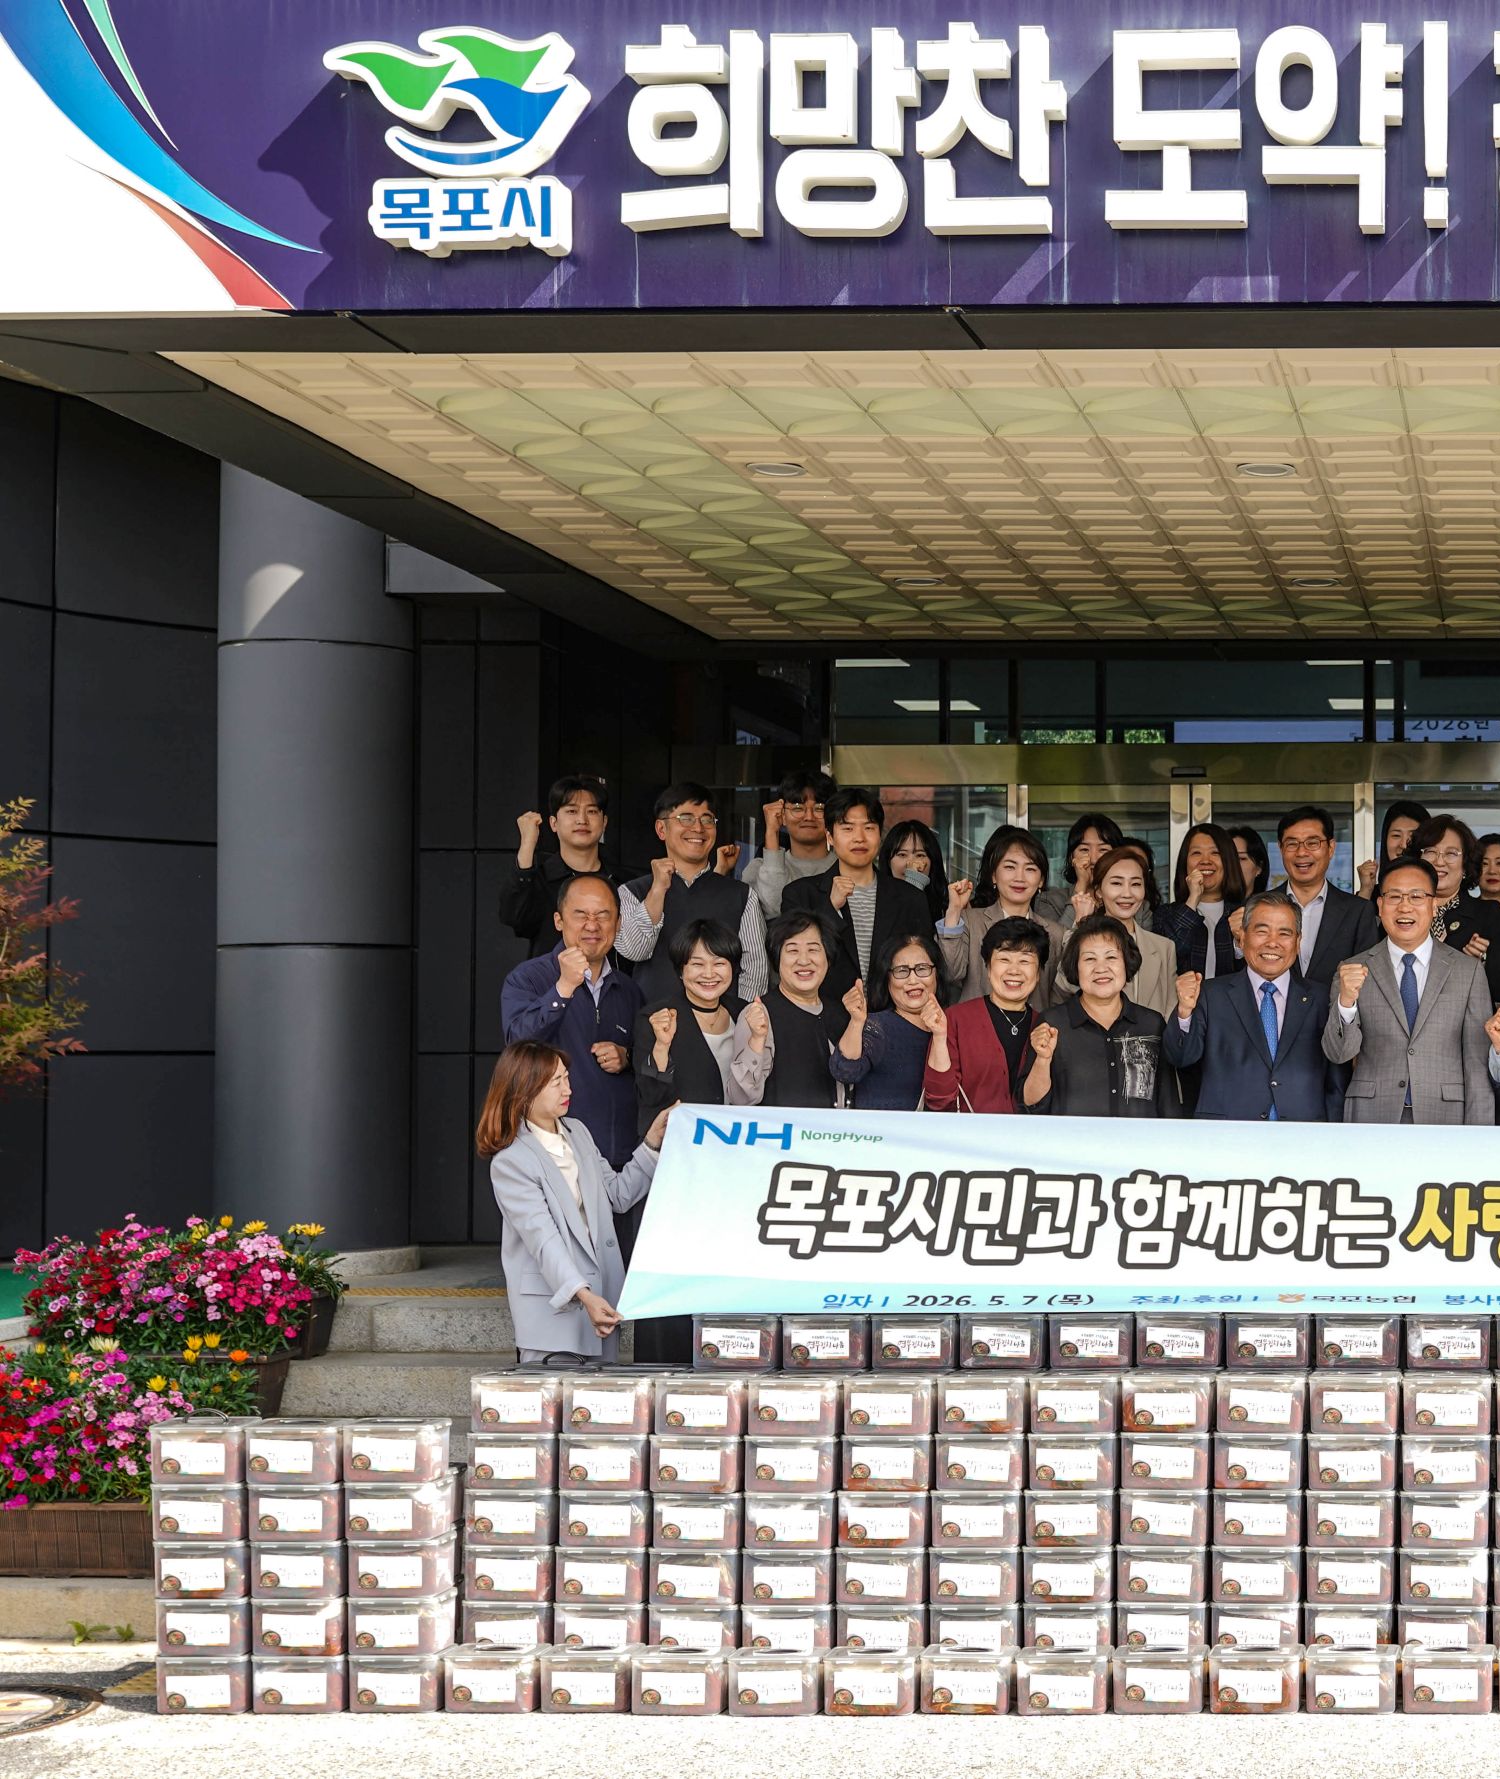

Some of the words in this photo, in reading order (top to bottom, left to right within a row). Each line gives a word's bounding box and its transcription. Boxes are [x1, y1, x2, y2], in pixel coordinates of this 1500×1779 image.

[622, 22, 1067, 236] 희망찬
[1105, 21, 1449, 235] 도약!
[380, 186, 551, 240] 목포시
[692, 1117, 794, 1151] NH
[801, 1129, 885, 1144] NongHyup
[758, 1161, 1107, 1266] 목포시민과
[1112, 1169, 1397, 1270] 함께하는
[822, 1294, 873, 1309] 일자
[902, 1294, 977, 1307] 2026.
[1021, 1295, 1039, 1306] 7
[1046, 1294, 1095, 1306] (목)
